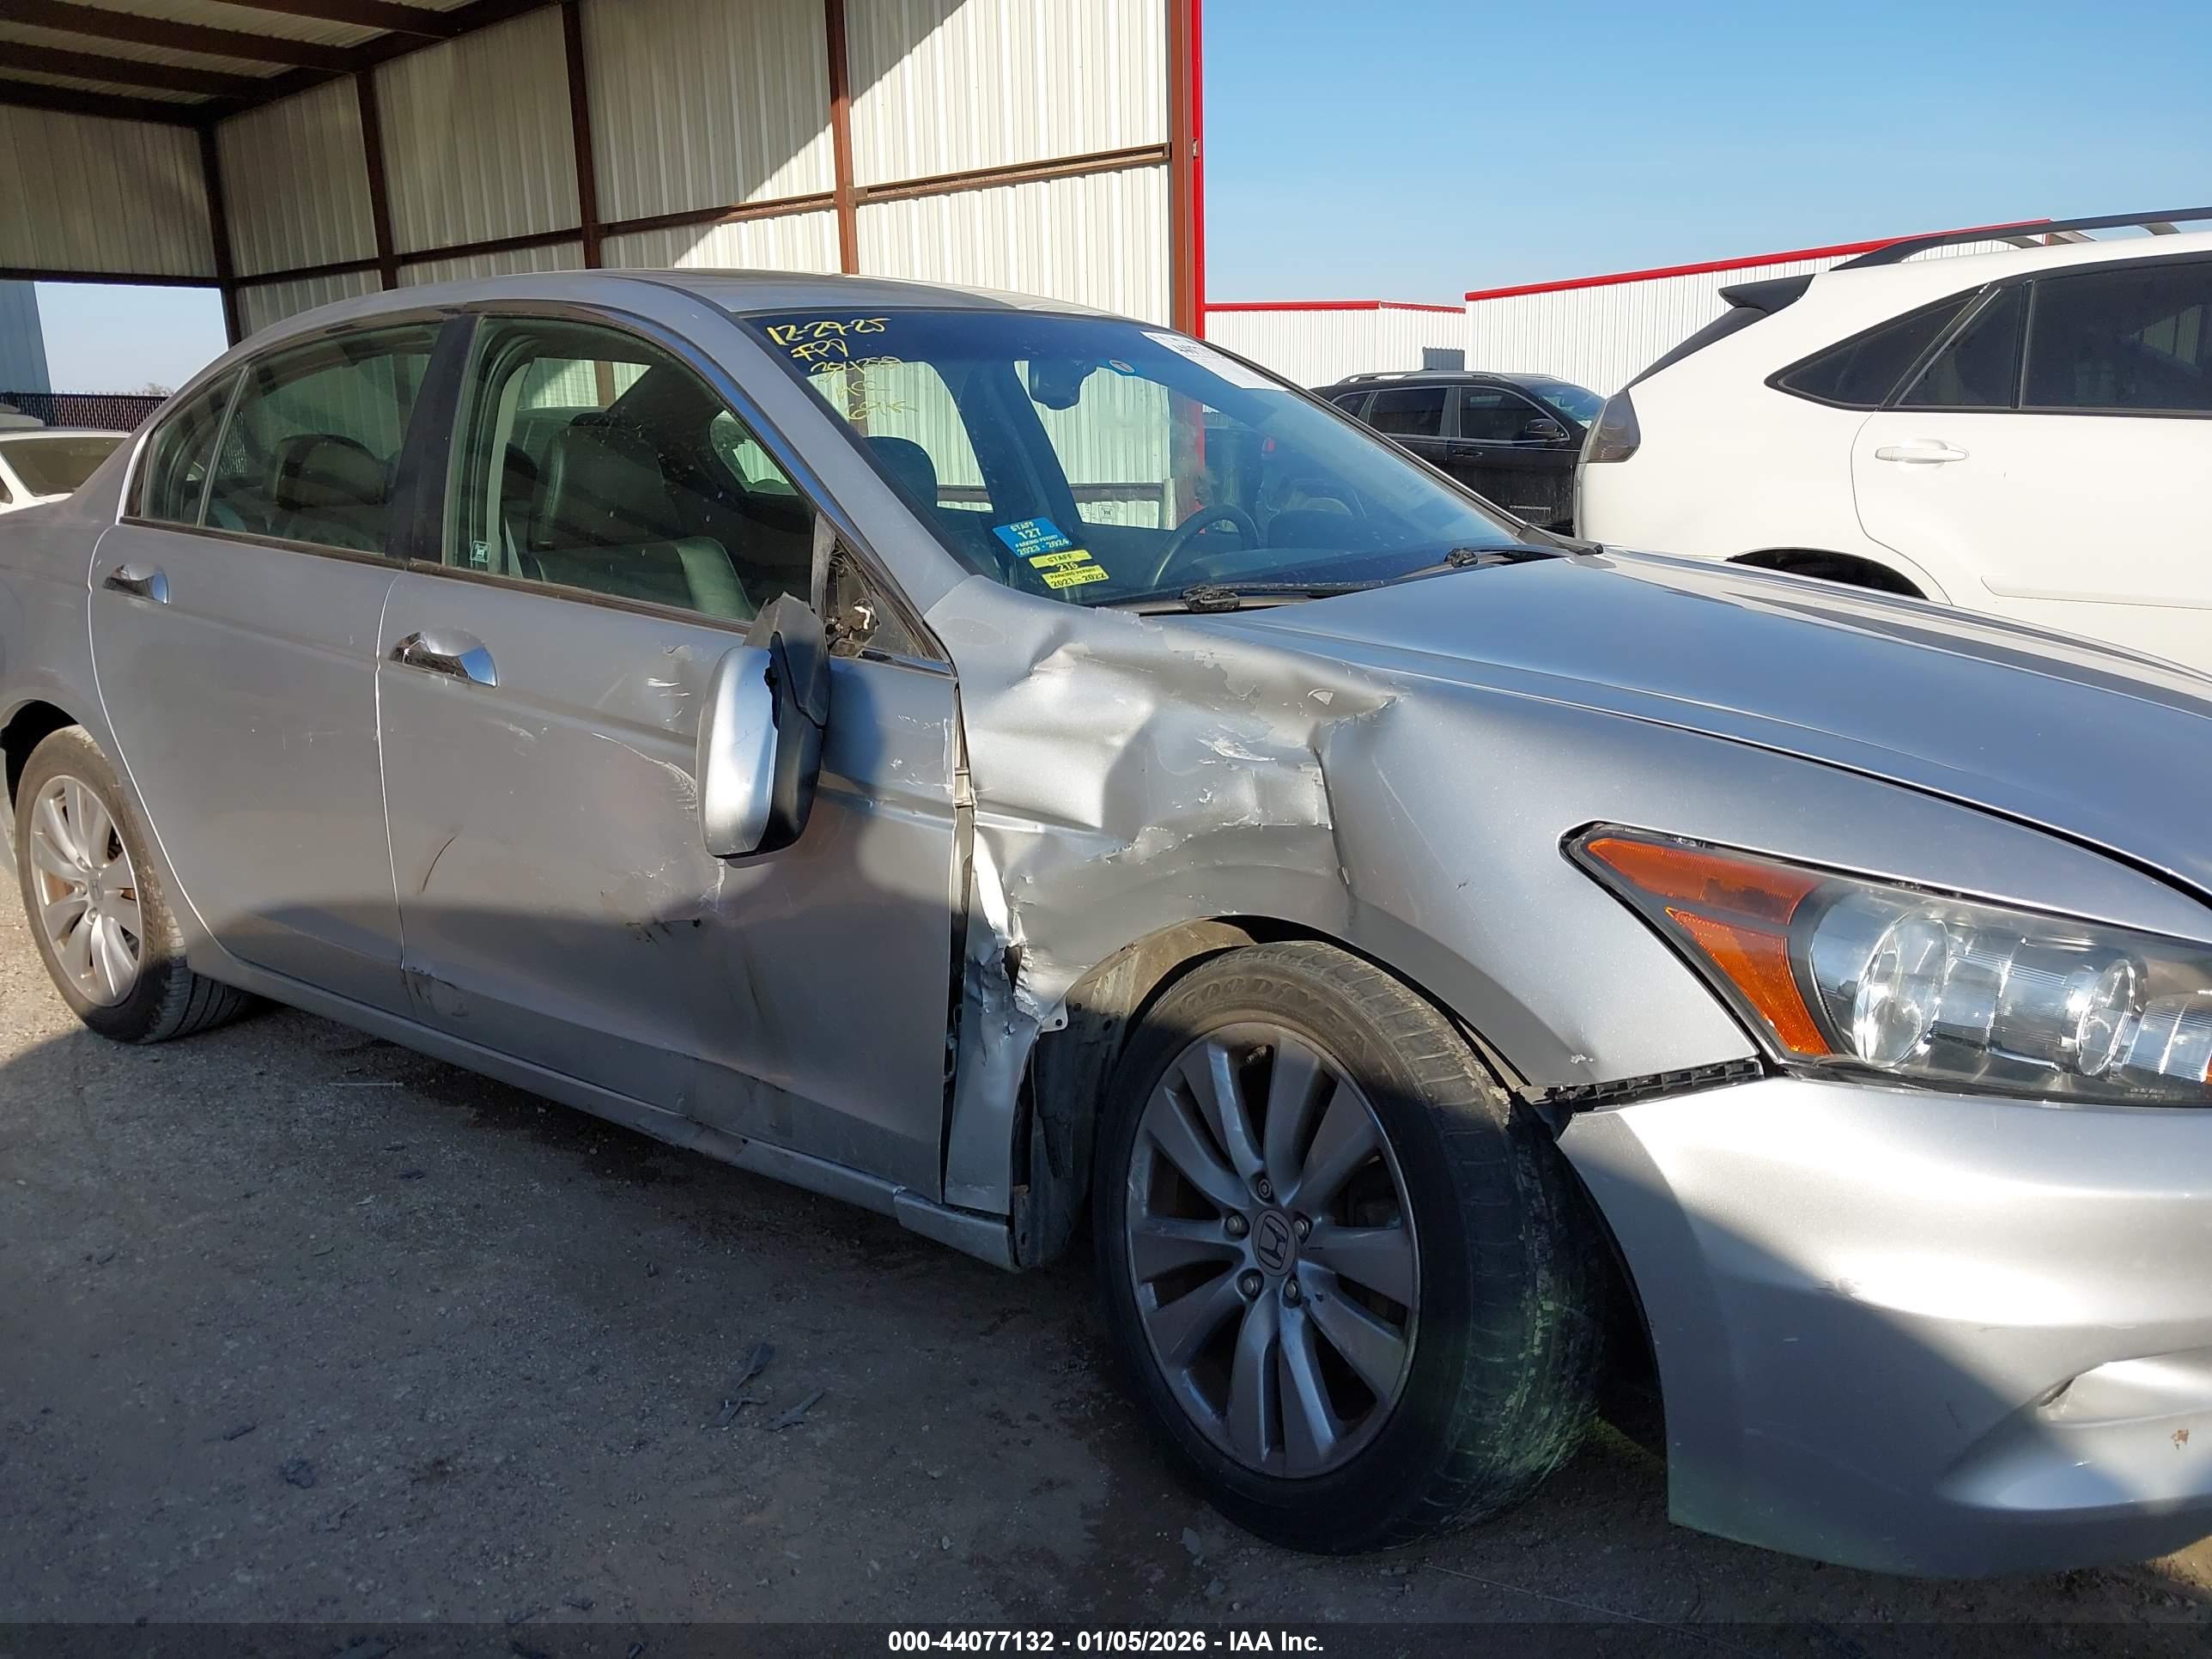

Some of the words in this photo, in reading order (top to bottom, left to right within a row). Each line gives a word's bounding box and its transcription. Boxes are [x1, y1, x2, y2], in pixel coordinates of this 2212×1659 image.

[767, 318, 892, 345] 12-29-25
[1010, 521, 1035, 532] STAFF
[1018, 527, 1042, 540] 127
[1015, 538, 1039, 548] PARKING
[1039, 534, 1058, 543] PERMIT
[1017, 544, 1041, 556] 2023
[1046, 538, 1070, 549] 2024
[1047, 553, 1073, 563] STAFF
[1056, 561, 1079, 572] 216
[1050, 571, 1075, 580] PARKING
[1051, 577, 1075, 587] 2021
[1082, 572, 1107, 582] 2022
